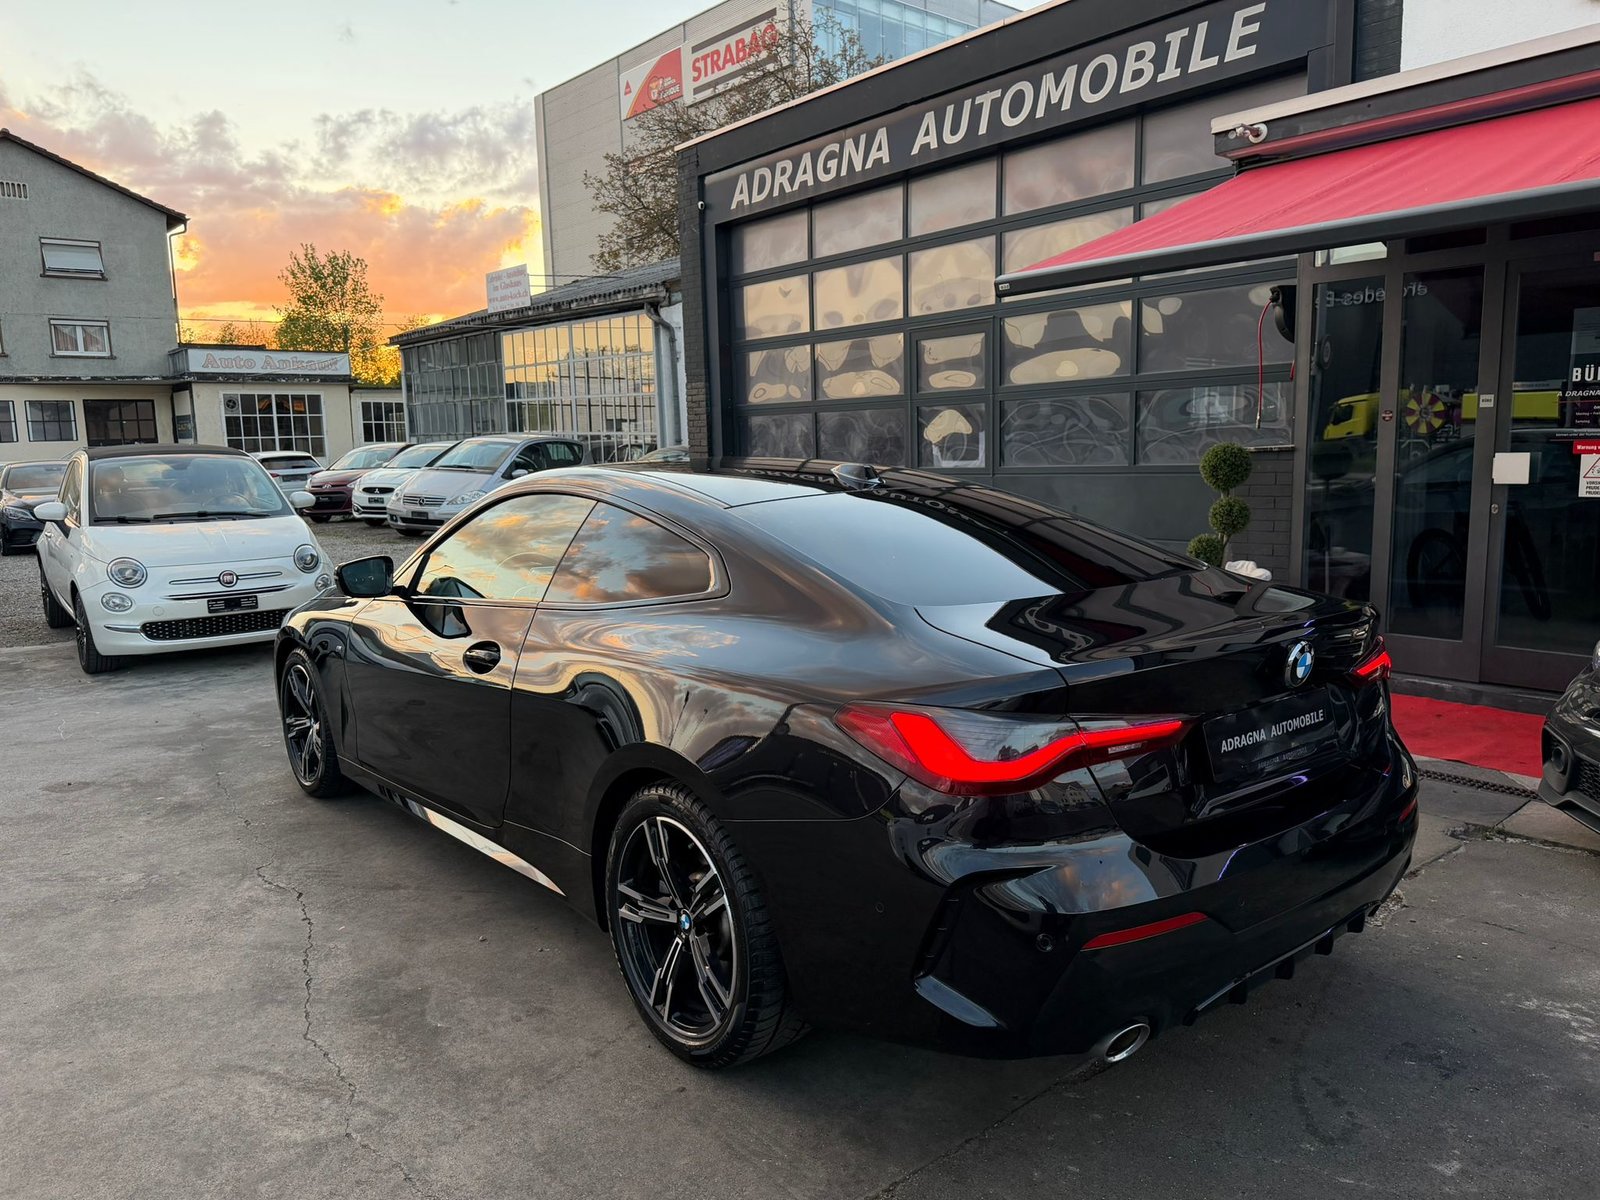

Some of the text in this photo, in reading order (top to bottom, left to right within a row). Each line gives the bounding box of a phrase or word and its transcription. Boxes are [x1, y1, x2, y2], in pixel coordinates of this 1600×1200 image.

[691, 22, 779, 83] STRABAG
[730, 2, 1267, 211] ADRAGNA AUTOMOBILE
[201, 353, 339, 372] Auto Ankauf
[1572, 364, 1600, 382] BÜ
[1221, 709, 1324, 753] ADRAGNA AUTOMOBILE
